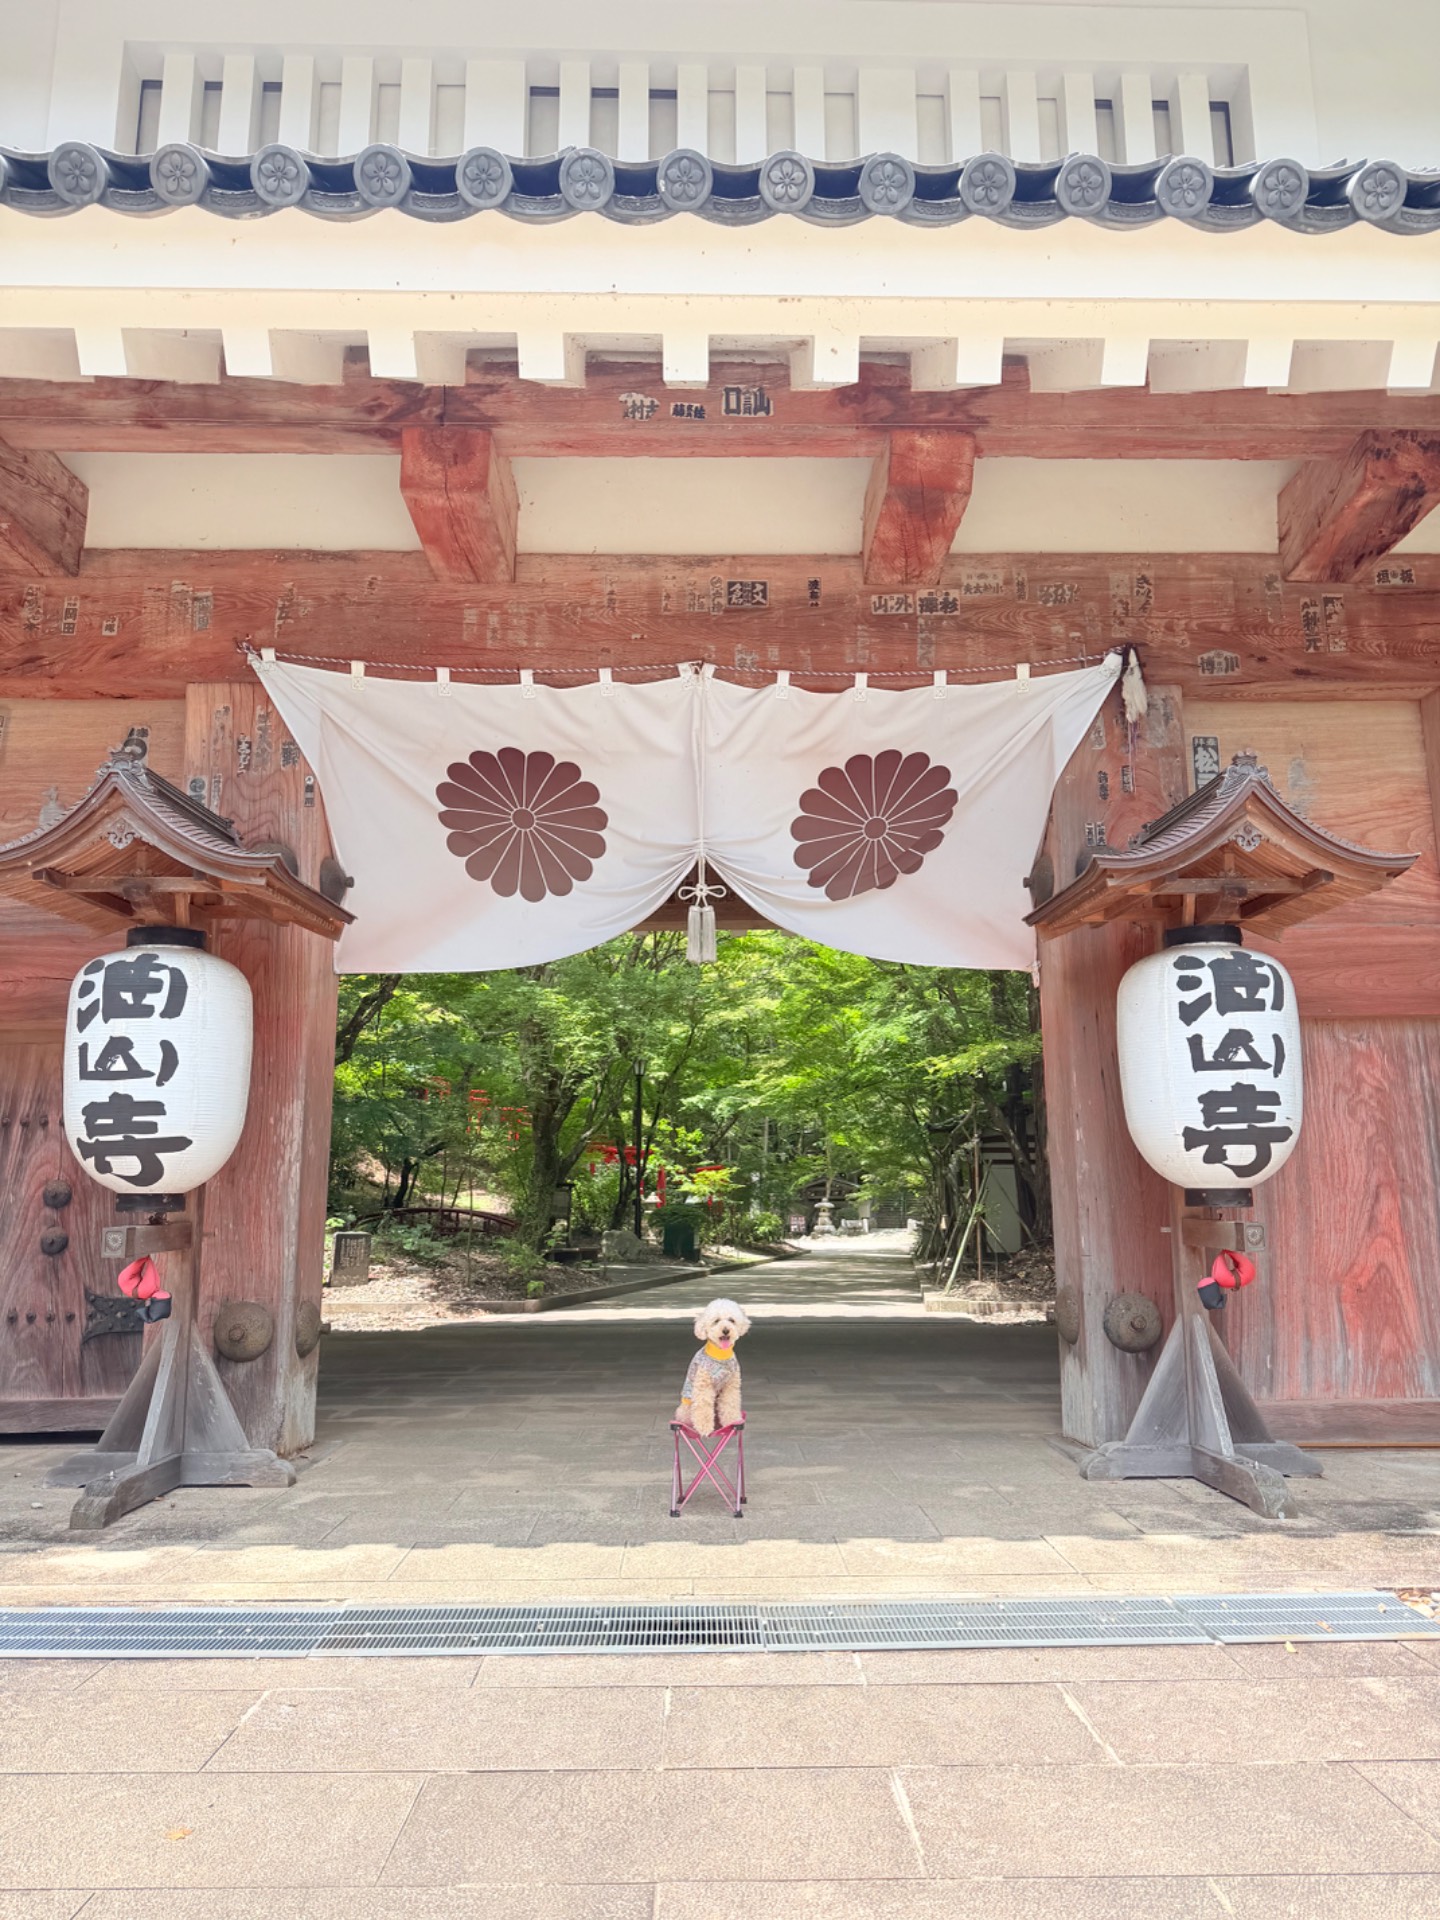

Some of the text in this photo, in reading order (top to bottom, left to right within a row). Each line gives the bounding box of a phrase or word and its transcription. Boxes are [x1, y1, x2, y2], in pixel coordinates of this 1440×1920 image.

[77, 953, 193, 1187] 油山寺
[1173, 951, 1293, 1178] 油山寺
